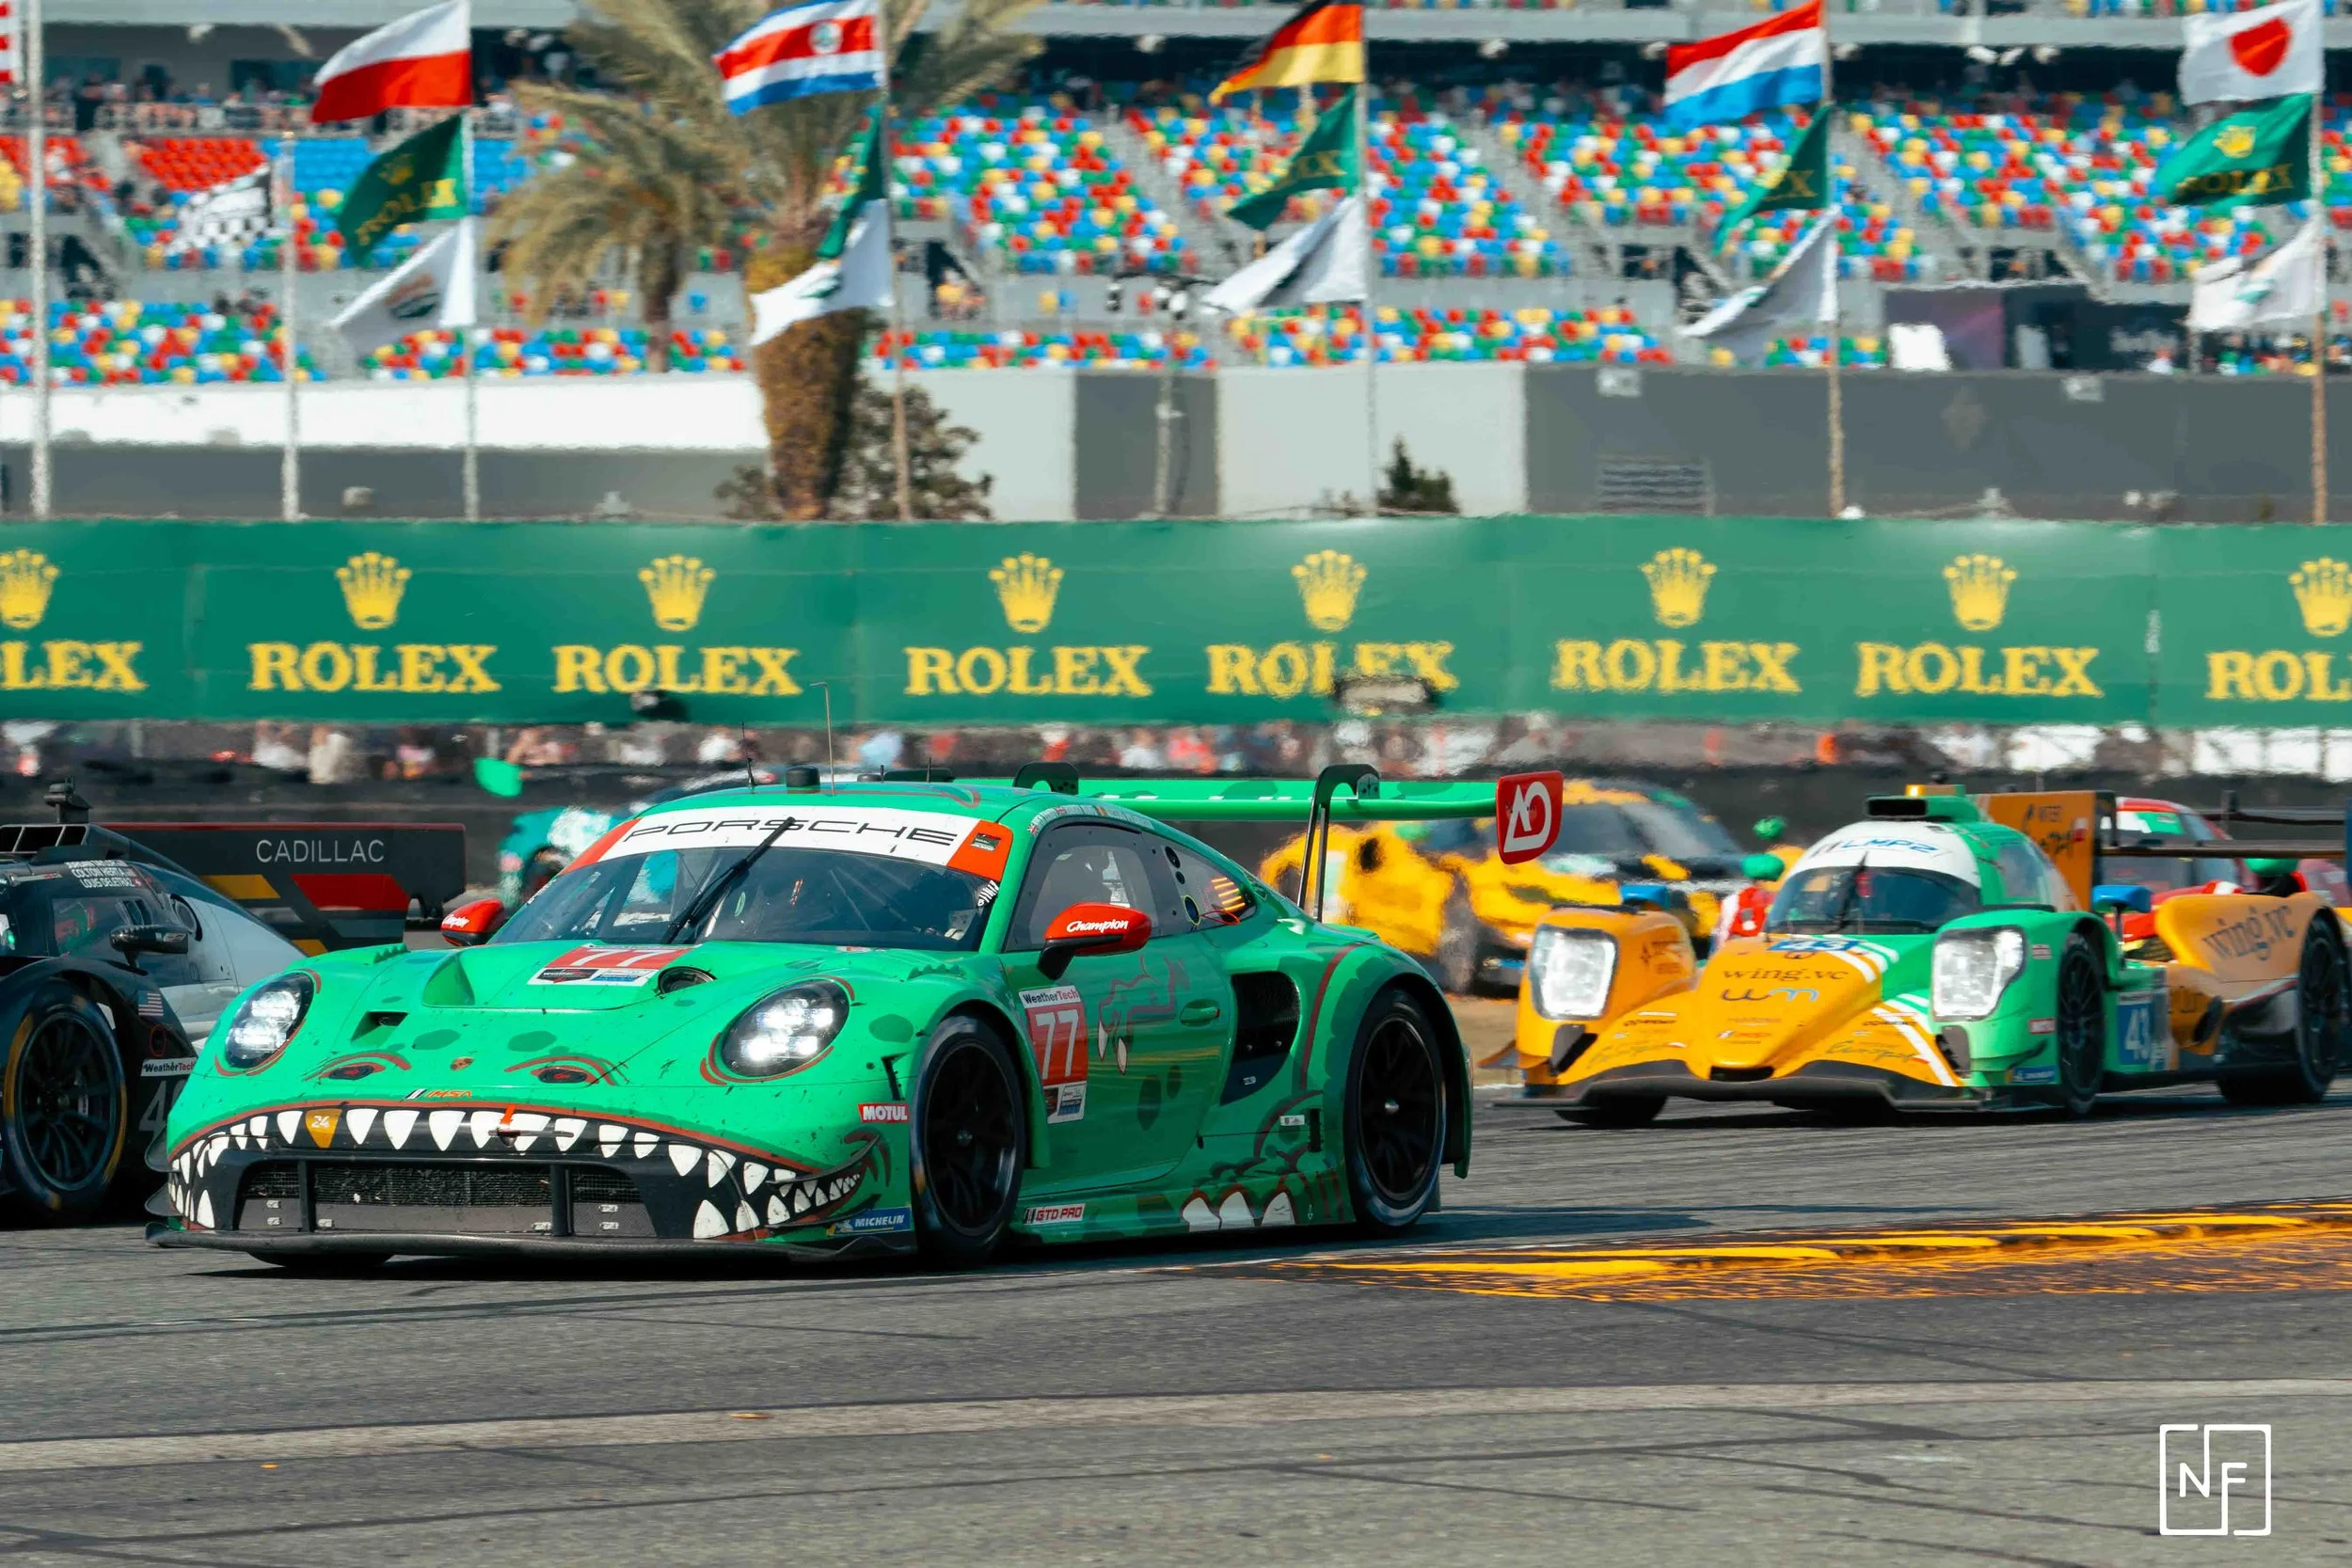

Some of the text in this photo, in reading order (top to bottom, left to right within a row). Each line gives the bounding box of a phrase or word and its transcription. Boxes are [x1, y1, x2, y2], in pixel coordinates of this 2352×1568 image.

[0, 641, 144, 690] LEX
[248, 641, 500, 692] ROLEX
[553, 643, 800, 694] ROLEX
[904, 644, 1151, 697] ROLEX
[1552, 638, 1799, 692] ROLEX
[1855, 641, 2105, 697] ROLEX
[2206, 649, 2352, 701] ROL
[623, 818, 958, 847] PORSCHE
[256, 839, 385, 863] CADILLAC
[1066, 919, 1129, 933] Champion
[570, 949, 675, 968] 77
[1723, 968, 1850, 982] wing.vc
[1023, 990, 1079, 1006] WeatherTech
[1035, 1009, 1080, 1081] 77
[426, 1089, 472, 1099] IMSA
[139, 1078, 186, 1140] 4
[310, 1115, 330, 1128] 24
[862, 1105, 909, 1121] MOTUL
[854, 1214, 905, 1228] MICHELIN
[1036, 1205, 1083, 1221] GTD PRO
